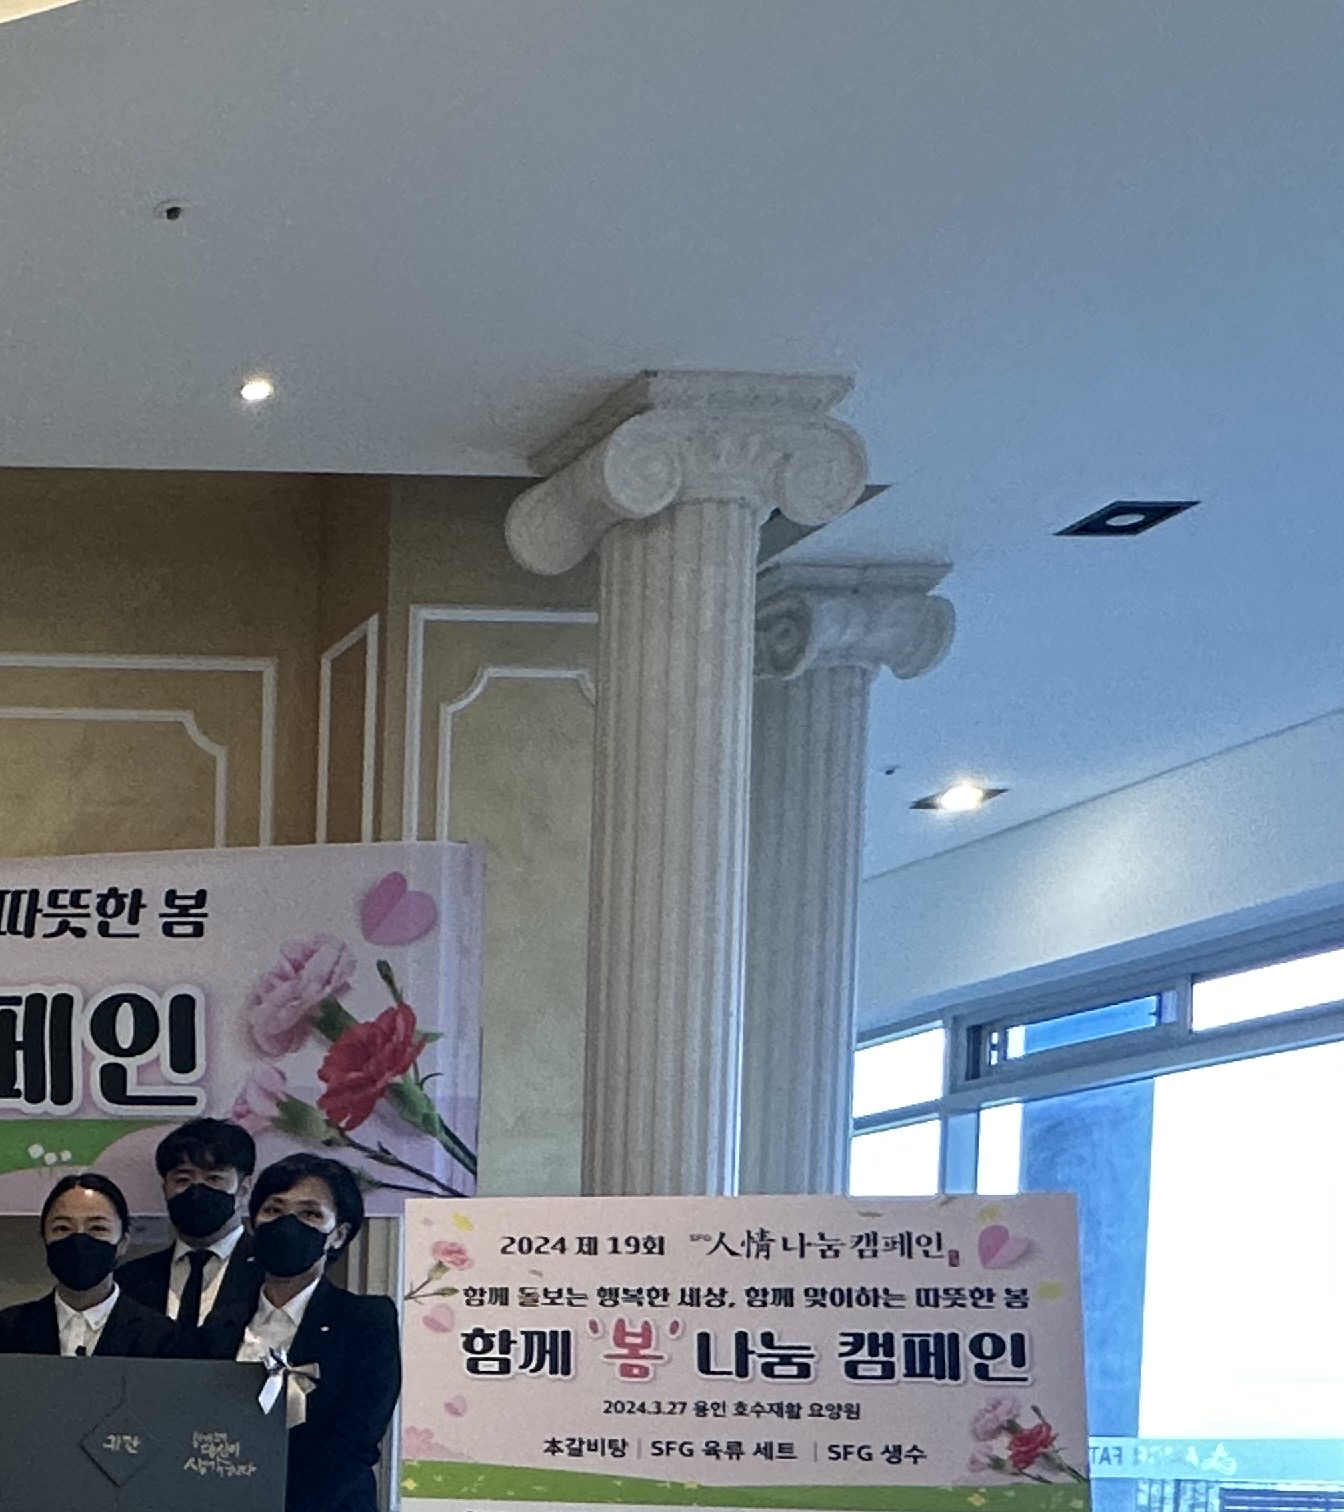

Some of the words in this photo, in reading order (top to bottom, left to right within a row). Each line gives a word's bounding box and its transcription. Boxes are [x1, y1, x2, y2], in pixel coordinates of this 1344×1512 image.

[159, 888, 210, 938] 봄
[500, 1235, 568, 1256] 2024
[575, 1235, 598, 1256] 제
[606, 1234, 666, 1257] 19회
[464, 1285, 510, 1308] 함께
[518, 1286, 588, 1309] 돌보는
[596, 1285, 670, 1309] 행복한
[744, 1286, 796, 1309] 함께
[803, 1286, 909, 1310] 맞이하는
[915, 1286, 997, 1310] 따뜻한
[1004, 1286, 1031, 1310] 봄
[460, 1326, 573, 1378] 함께
[696, 1329, 816, 1381] 나눔
[838, 1329, 1030, 1383] 캠페인
[602, 1400, 688, 1416] 2024.3.27
[692, 1400, 728, 1418] 용인
[732, 1400, 803, 1420] 호수재활
[807, 1401, 862, 1421] 요양원
[543, 1436, 629, 1459] 本갈비탕
[650, 1440, 694, 1459] SFG
[701, 1440, 746, 1462] 육류
[752, 1441, 798, 1462] 세트
[827, 1444, 874, 1463] SFG
[880, 1443, 928, 1466] 생수
